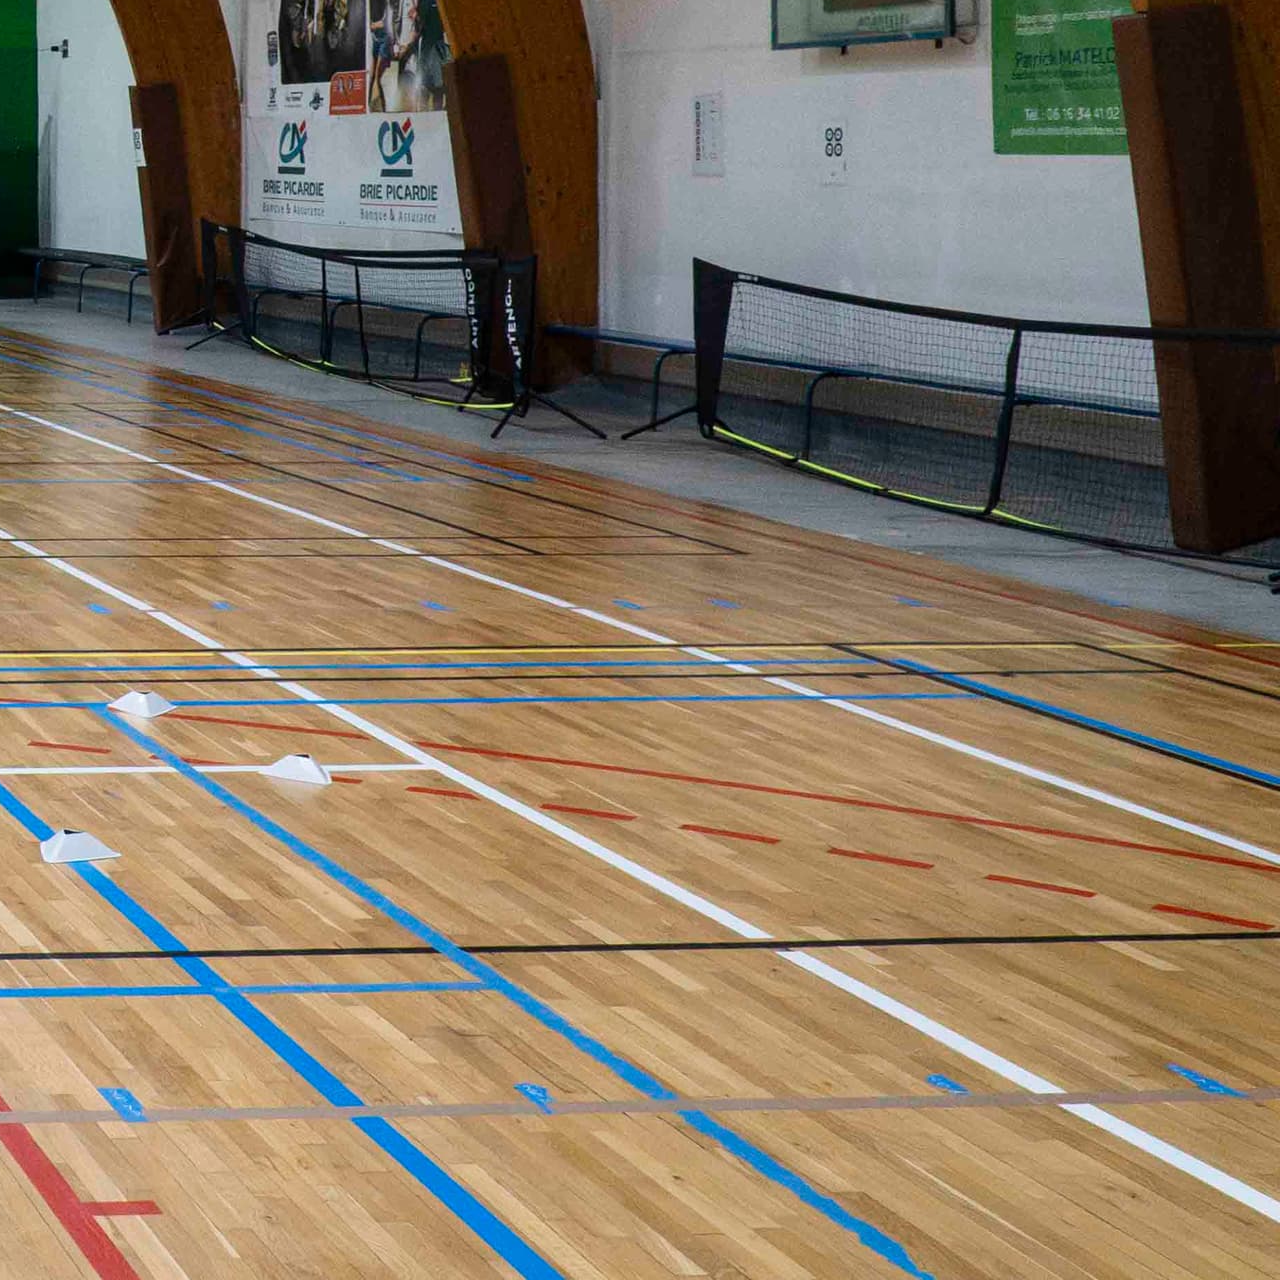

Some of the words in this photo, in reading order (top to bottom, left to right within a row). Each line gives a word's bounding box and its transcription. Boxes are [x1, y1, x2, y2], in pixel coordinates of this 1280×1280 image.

[263, 179, 281, 194] BRIE
[283, 180, 325, 197] PICARDIE
[360, 183, 383, 200] BRIE
[385, 184, 438, 201] PICARDIE
